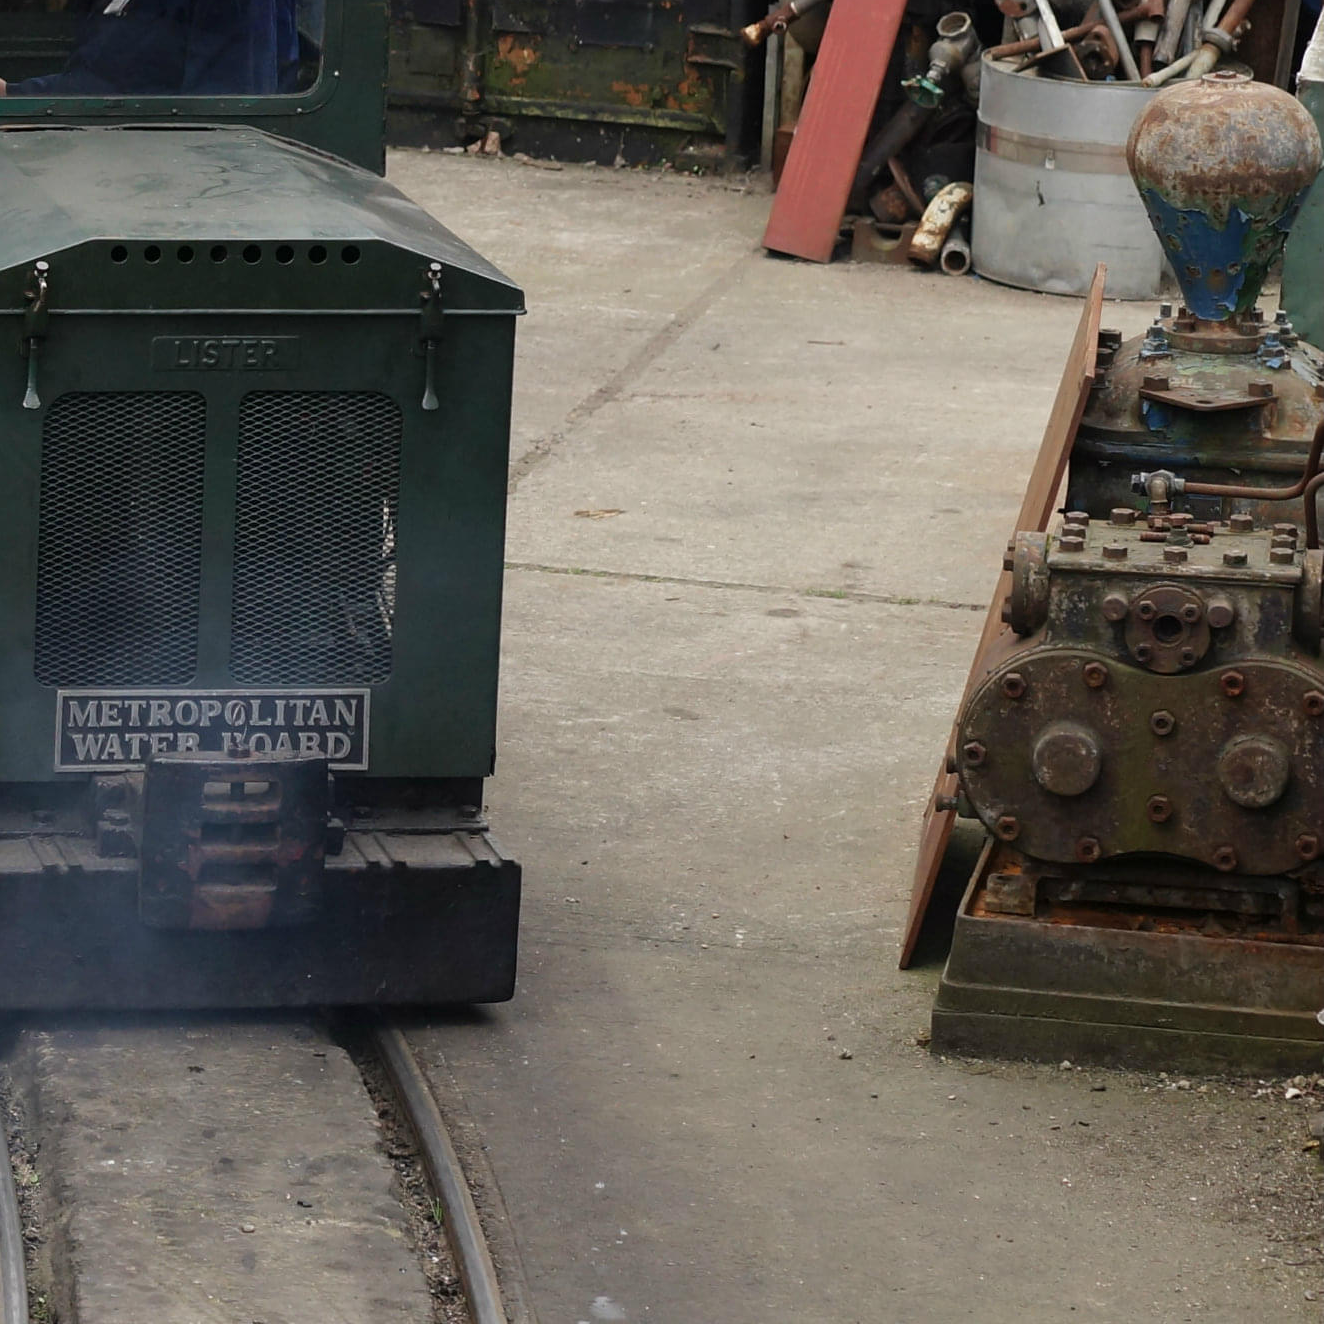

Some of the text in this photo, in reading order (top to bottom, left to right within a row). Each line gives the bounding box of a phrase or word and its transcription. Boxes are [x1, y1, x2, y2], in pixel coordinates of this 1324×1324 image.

[174, 340, 279, 367] LISTER
[67, 699, 358, 727] METROPOLITAN
[71, 731, 352, 761] WATER BOARD
